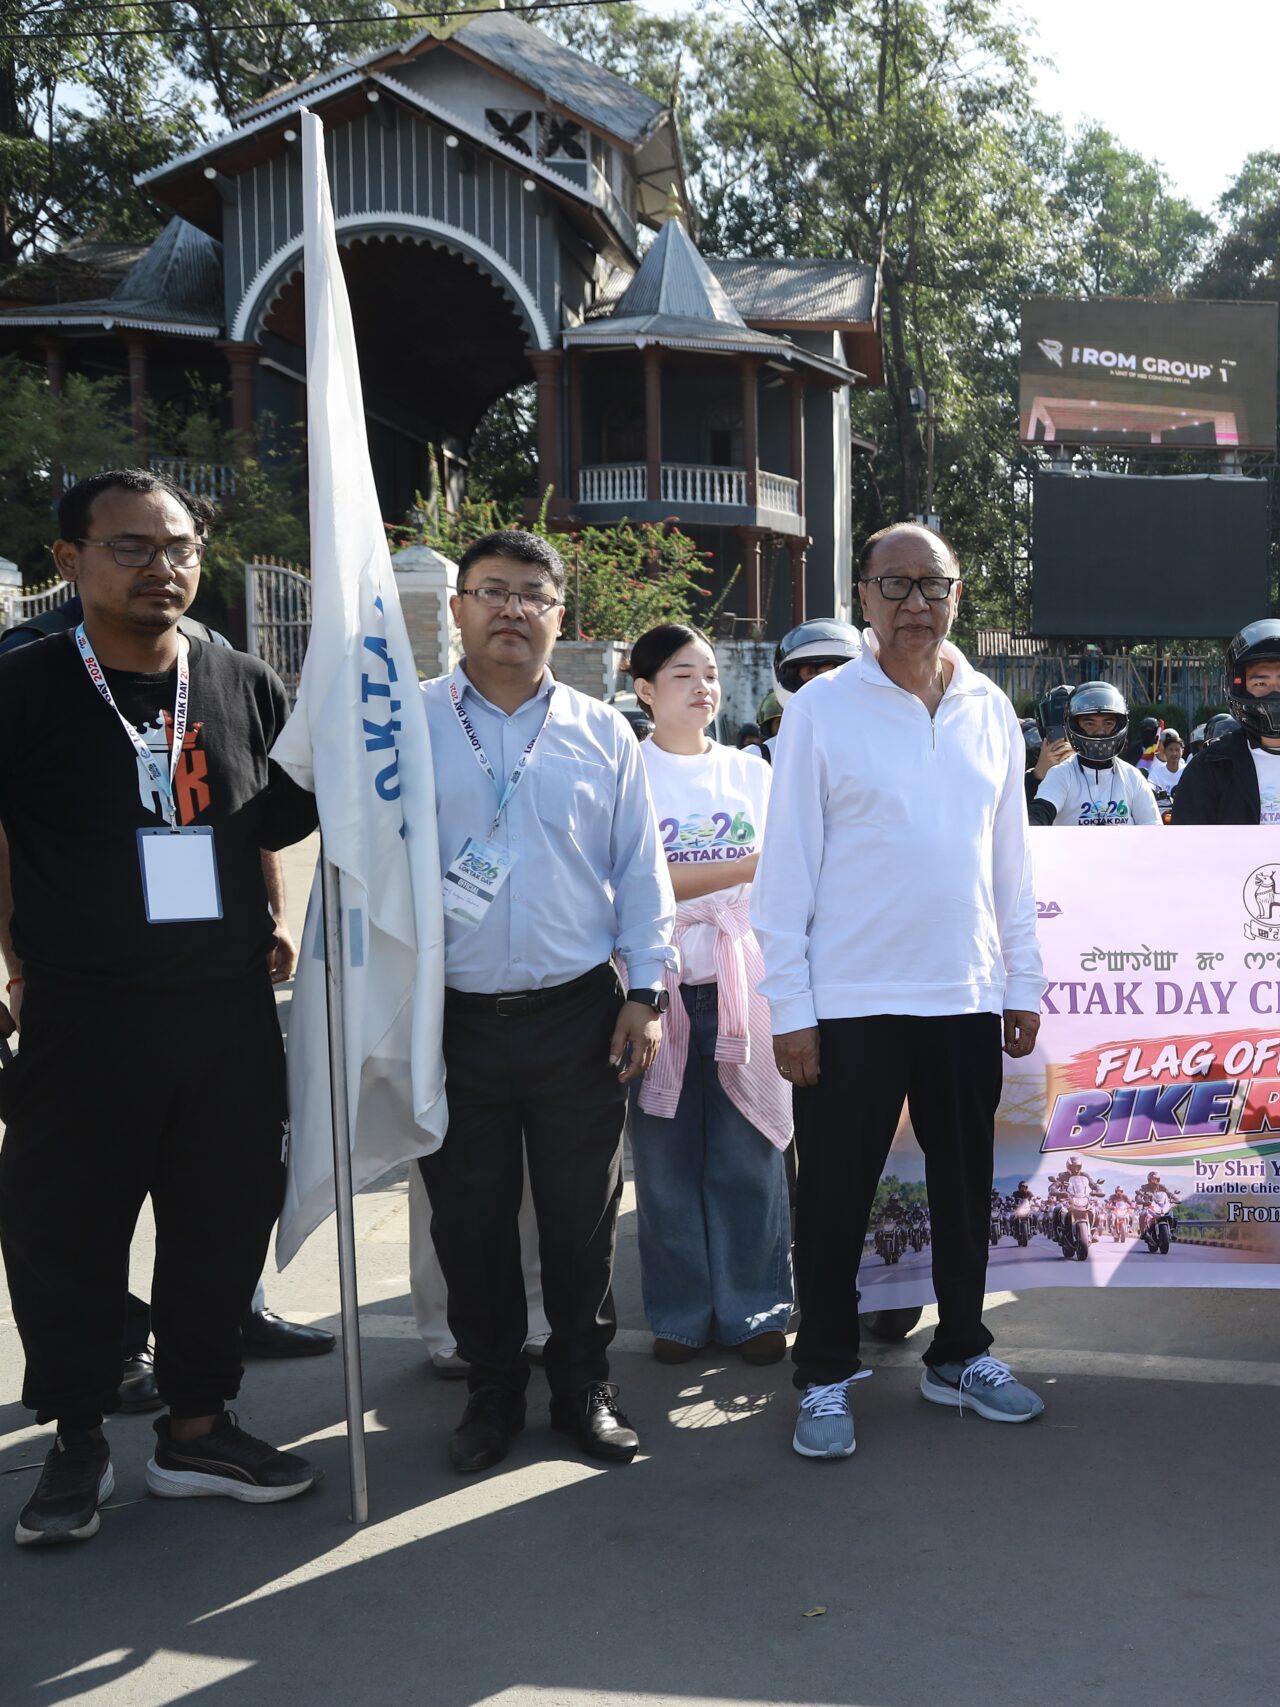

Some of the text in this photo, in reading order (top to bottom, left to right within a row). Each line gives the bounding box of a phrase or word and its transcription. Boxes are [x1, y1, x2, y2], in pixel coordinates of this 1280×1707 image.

[1142, 357, 1211, 379] GROUP
[85, 657, 102, 682] 2026
[178, 682, 188, 700] DAY
[176, 701, 188, 740] LOKTAK
[453, 701, 466, 718] DAY
[460, 717, 481, 751] LOKTAK
[1115, 817, 1128, 825] DAY
[667, 848, 723, 862] OKTAK
[459, 864, 480, 880] LOKTAK
[463, 853, 499, 880] 2026
[1035, 901, 1062, 912] DA
[1039, 981, 1144, 1015] KTAK
[1155, 981, 1237, 1015] DAY
[1095, 1041, 1216, 1088] FLAG
[1040, 1078, 1240, 1153] BIKE
[1195, 1160, 1219, 1180] by
[1225, 1160, 1265, 1176] Shri
